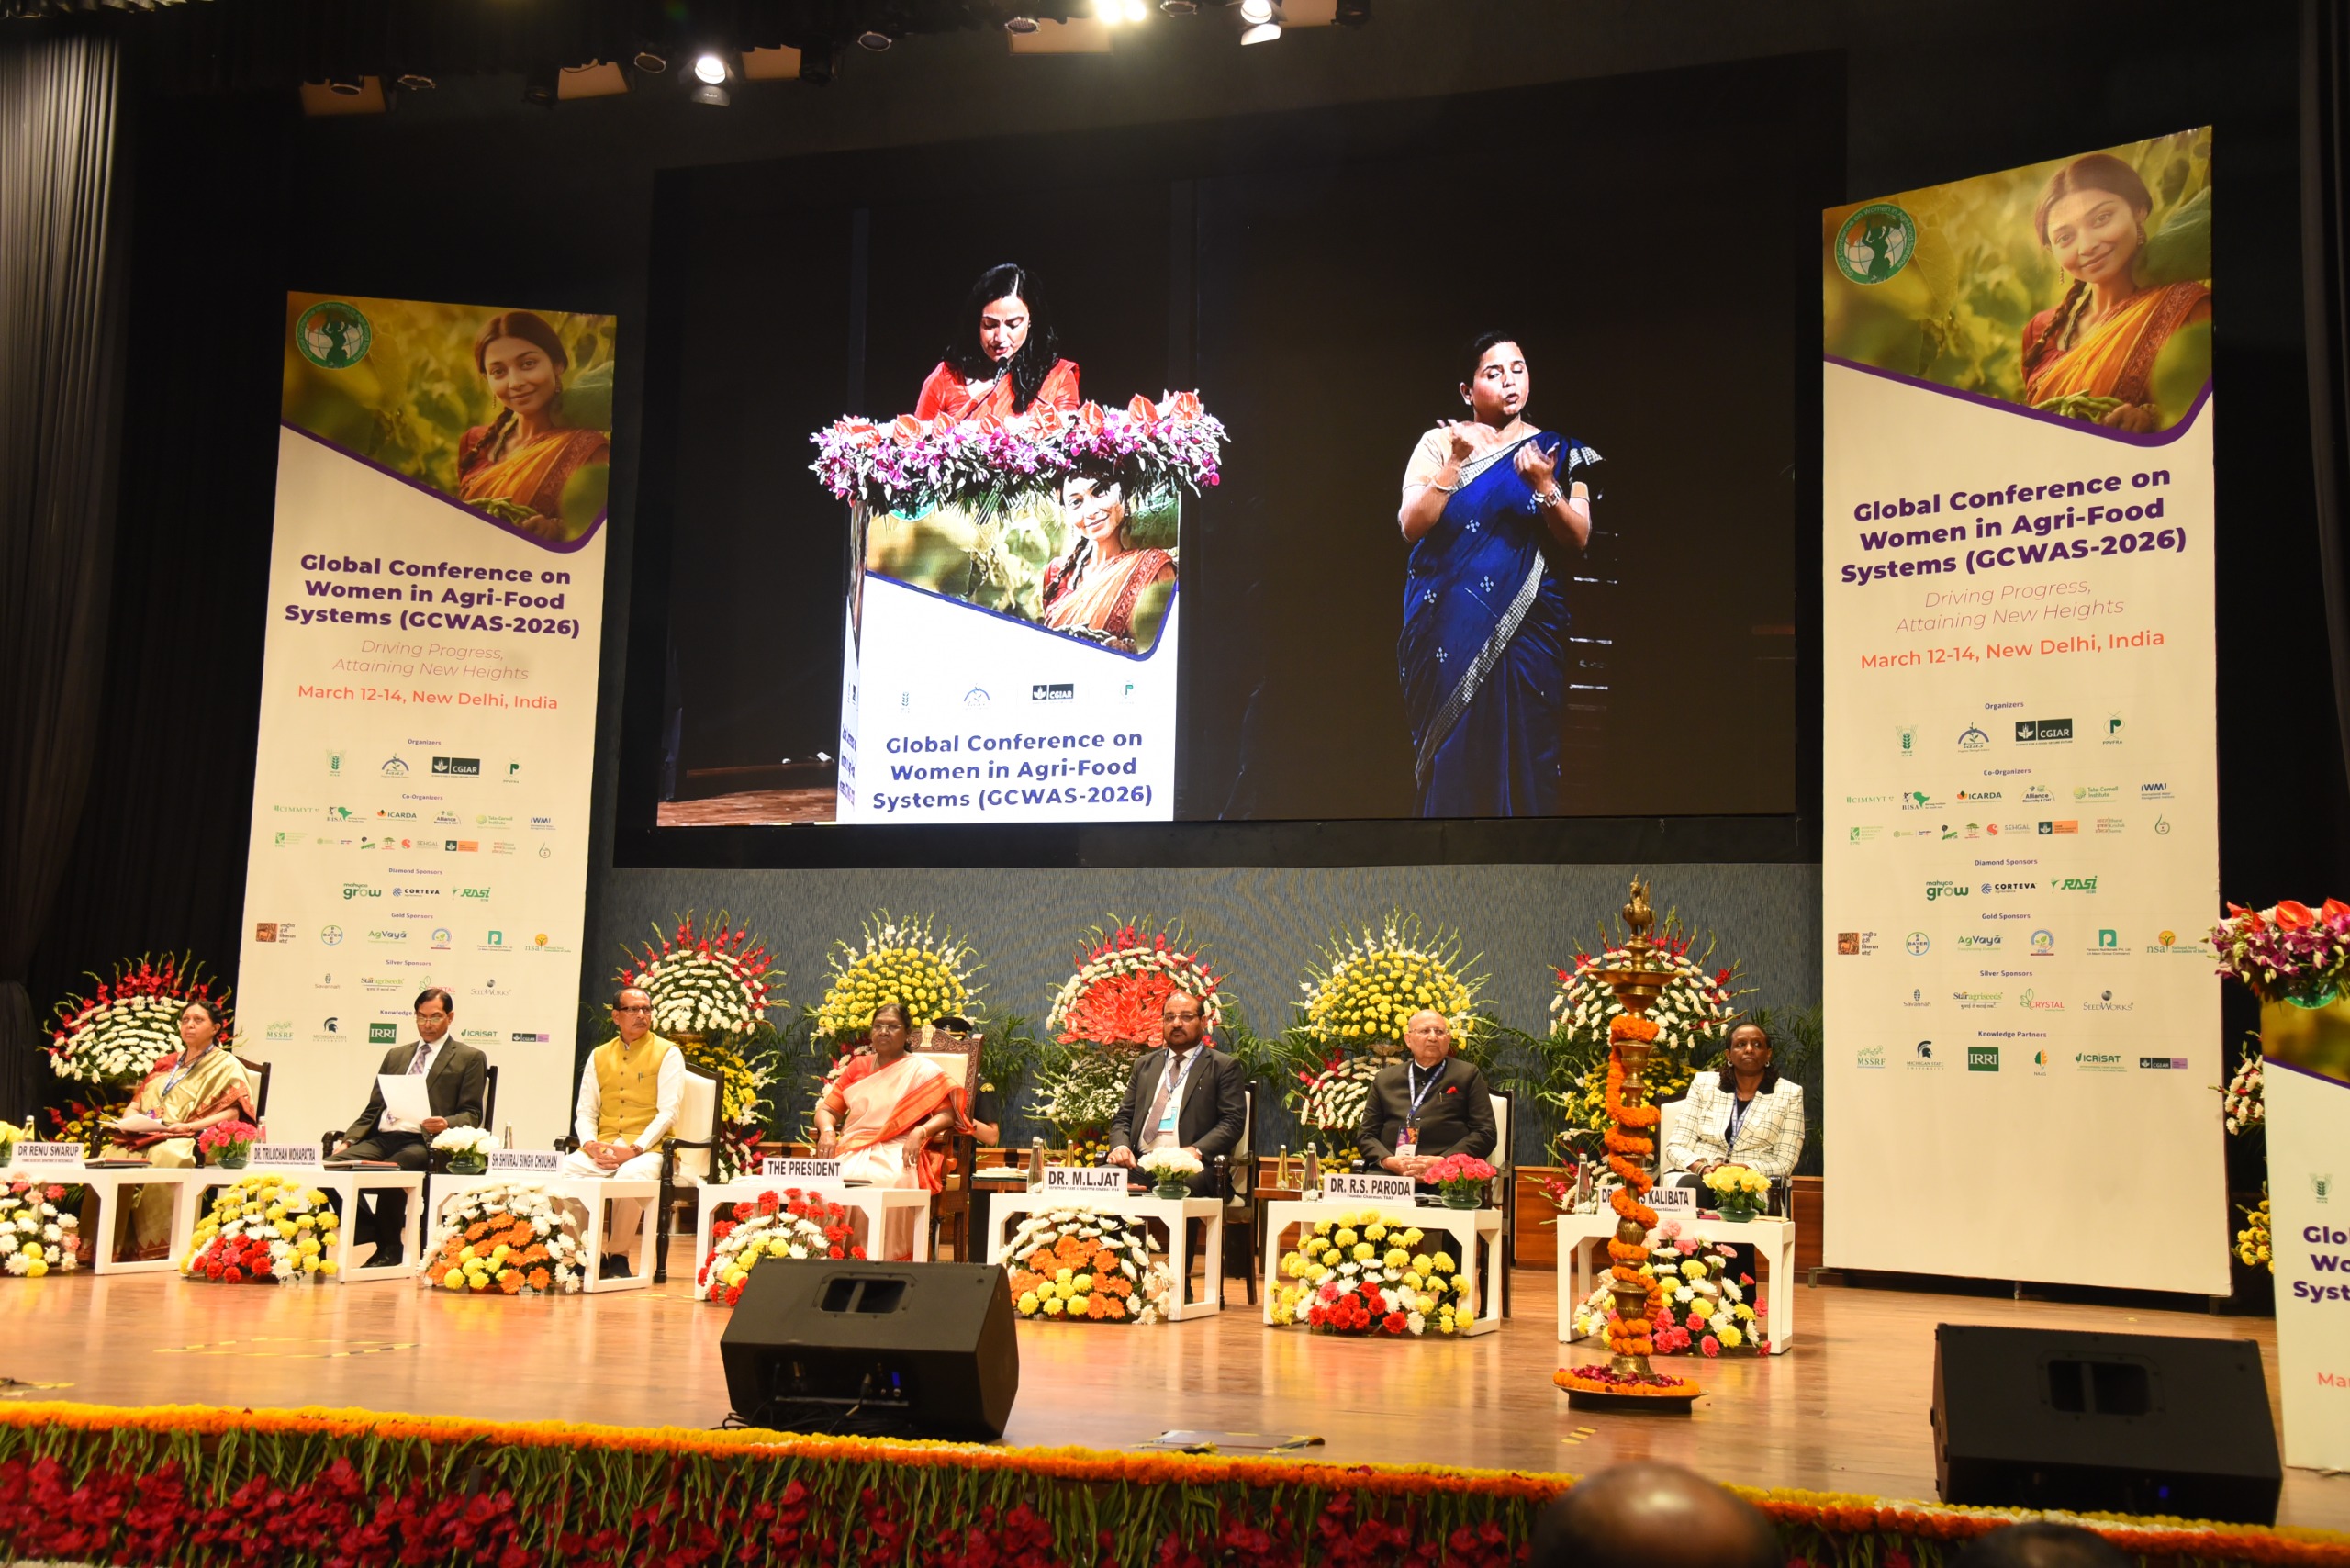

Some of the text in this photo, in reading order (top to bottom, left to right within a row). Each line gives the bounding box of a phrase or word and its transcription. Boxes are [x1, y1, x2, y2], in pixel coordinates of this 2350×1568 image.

[1863, 206, 1891, 215] Women
[1852, 469, 2170, 521] Global Conference on
[1860, 498, 2165, 551] Women in Agri-Food
[1841, 527, 2187, 586] Systems (GCWAS-2026)
[300, 554, 571, 585] Global Conference on
[305, 579, 565, 610] Women in Agri-Food
[1924, 579, 2092, 609] Driving Progress,
[285, 605, 580, 640] Systems (GCWAS-2026)
[1895, 599, 2125, 633] Attaining New Heights
[361, 639, 505, 662] Driving Progress,
[1861, 629, 2165, 669] March 12-14, New Delhi, India
[332, 657, 530, 682] Attaining New Heights
[297, 685, 559, 711] March 12-14, New Delhi, India
[1049, 689, 1073, 700] CGIAR
[1985, 701, 2024, 711] Organizers
[2040, 728, 2070, 738] CGIAR
[885, 732, 1143, 755] Global Conference on
[453, 765, 478, 774] CGIAR
[890, 757, 1137, 781] Women in Agri-Food
[1983, 767, 2031, 777] Co-Organizers
[872, 784, 1153, 812] Systems (GCWAS-2026)
[1852, 796, 1886, 804] CIMMYT
[343, 888, 382, 900] grow
[1926, 886, 1969, 902] grow
[1999, 913, 2031, 921] Sponsors
[2029, 1001, 2065, 1009] CRYSTAL
[370, 1027, 396, 1039] IRRI
[1978, 1030, 2016, 1038] Knowledge
[1857, 1058, 1886, 1066] MSSRF
[1969, 1053, 1998, 1065] IRRI
[18, 1145, 80, 1157] DR RENU SWARUP
[263, 1148, 288, 1161] TRILOCHAN
[289, 1148, 316, 1161] MOHAPATRA
[499, 1153, 519, 1168] SHIVRAJ
[520, 1154, 534, 1168] SINGH
[534, 1155, 558, 1169] CHOUHAN
[768, 1160, 841, 1177] THE PRESIDENT
[1048, 1170, 1069, 1186] DR.
[1330, 1177, 1411, 1196] DR. R.S. PARODA
[1648, 1190, 1690, 1206] KALIBATA
[2303, 1226, 2350, 1245] Glo
